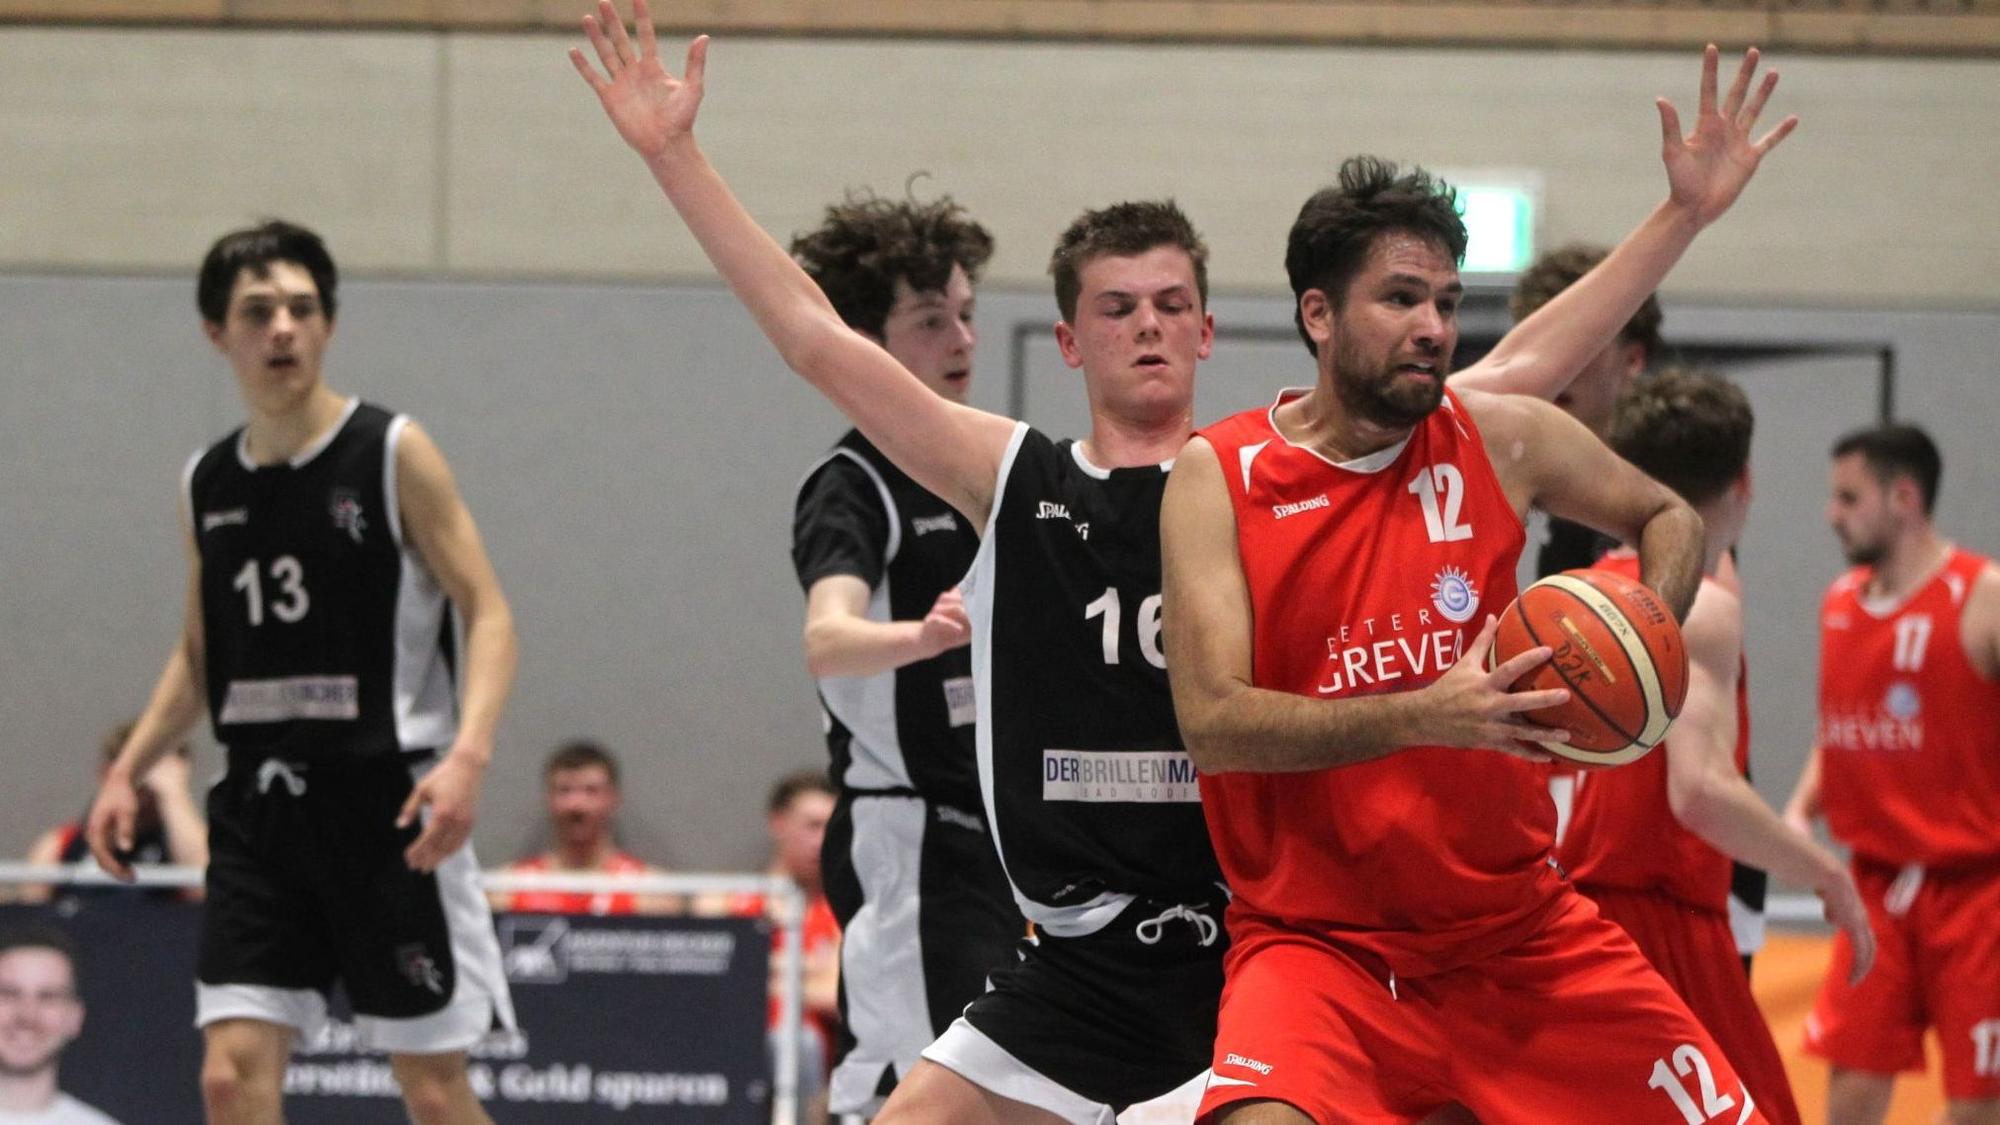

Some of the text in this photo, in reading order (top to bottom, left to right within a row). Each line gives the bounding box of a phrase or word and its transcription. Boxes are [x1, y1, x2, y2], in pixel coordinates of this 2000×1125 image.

[1036, 501, 1089, 541] SPALG
[1272, 493, 1330, 519] SPALDING
[1408, 464, 1473, 543] 12
[233, 555, 310, 626] 13
[1085, 586, 1168, 669] 16
[1223, 1052, 1273, 1076] SPALDING
[1648, 1044, 1736, 1125] 12
